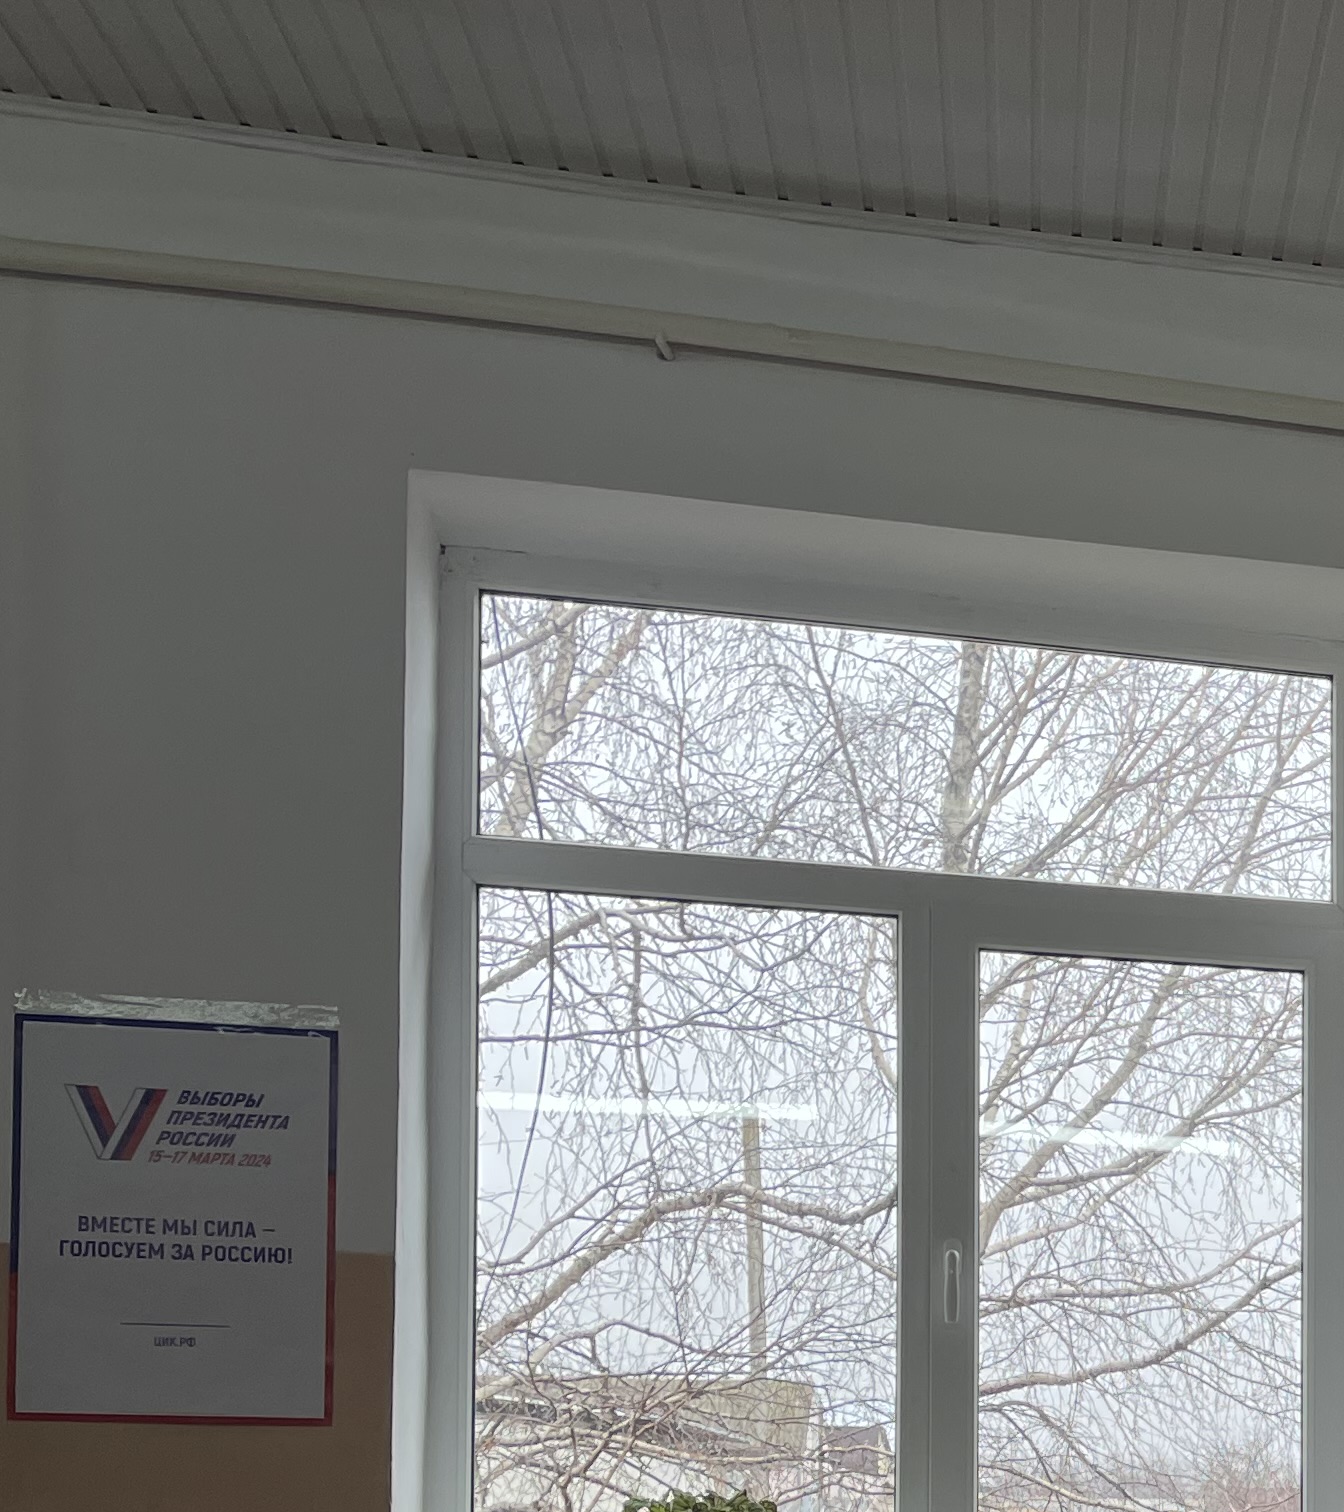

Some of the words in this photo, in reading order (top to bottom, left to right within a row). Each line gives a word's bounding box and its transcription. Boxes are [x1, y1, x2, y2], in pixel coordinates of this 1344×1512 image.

[177, 1089, 264, 1108] ВЫБОРЫ
[166, 1110, 290, 1130] ПРЕЗИДЕНТА
[156, 1131, 236, 1148] РОССИИ
[189, 1151, 235, 1166] МАРТА
[238, 1153, 271, 1168] 2024
[78, 1215, 156, 1235] ВМЕСТЕ
[162, 1219, 197, 1237] МЫ
[204, 1220, 257, 1238] СИЛА
[59, 1240, 165, 1260] ГОЛОСУЕМ
[171, 1243, 195, 1261] ЗА
[201, 1245, 293, 1264] РОССИЮ!
